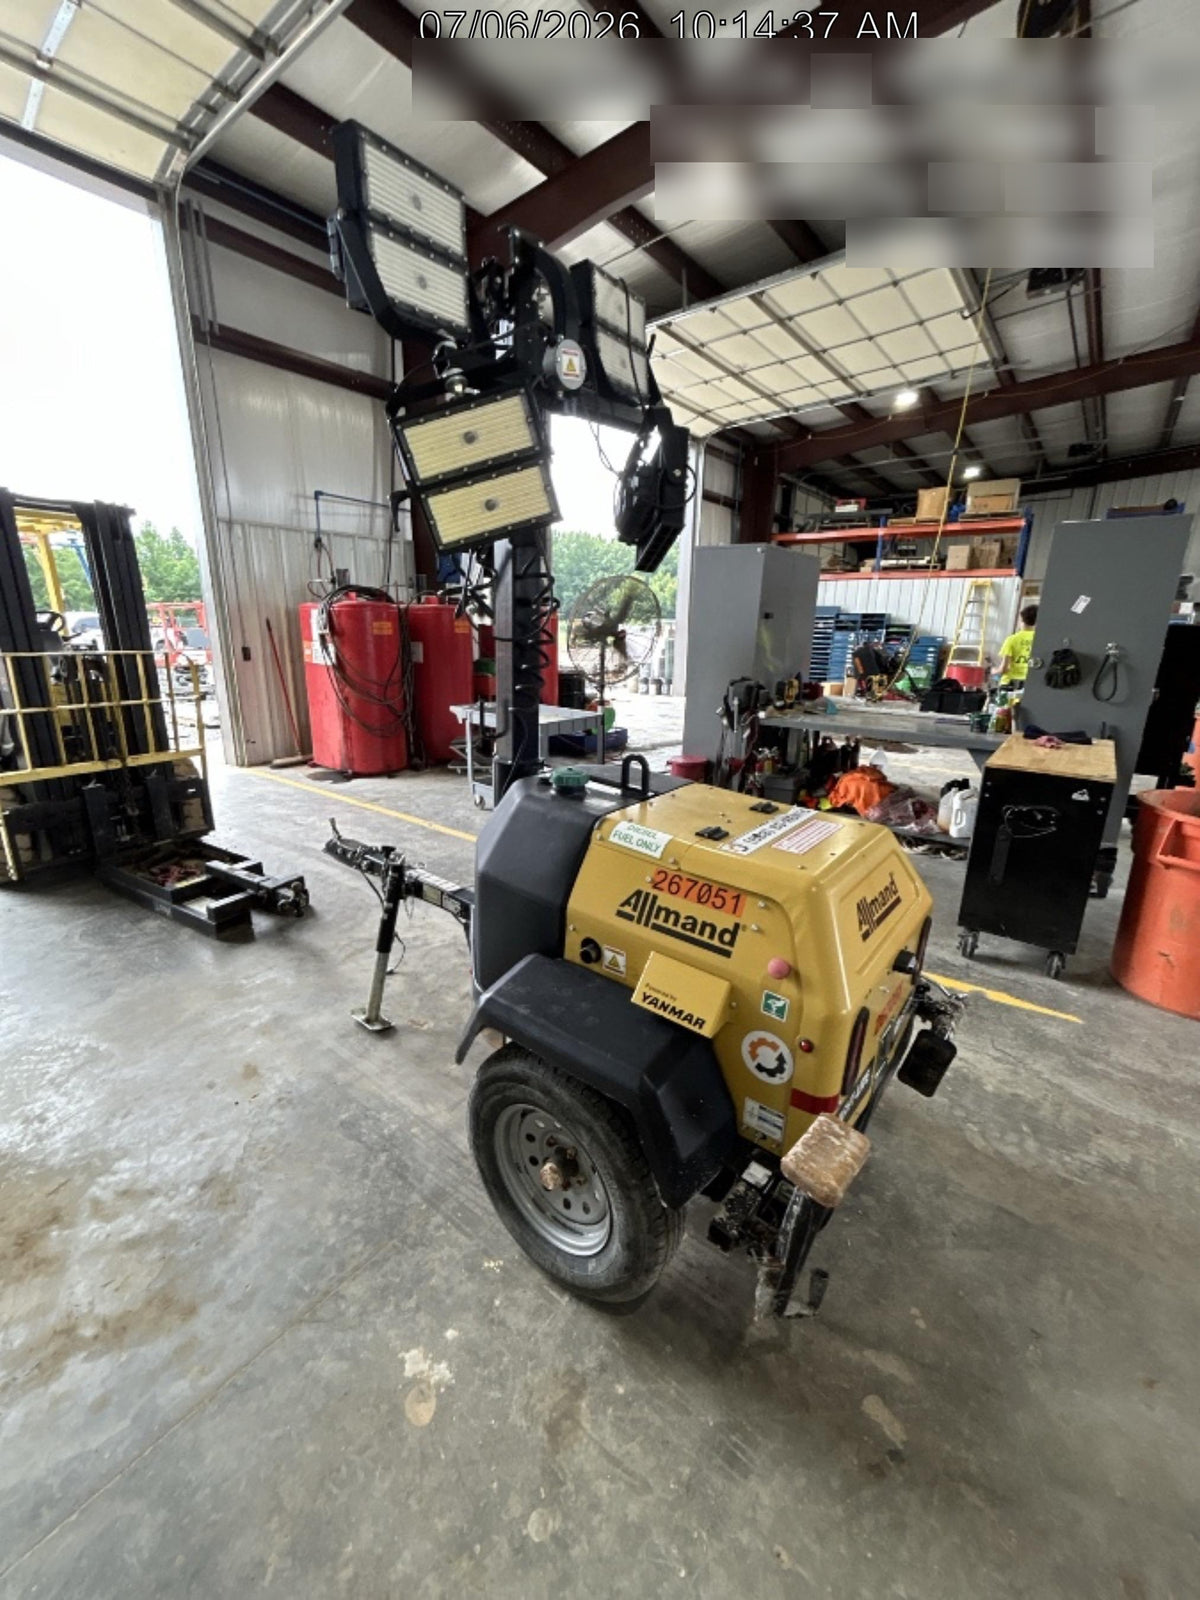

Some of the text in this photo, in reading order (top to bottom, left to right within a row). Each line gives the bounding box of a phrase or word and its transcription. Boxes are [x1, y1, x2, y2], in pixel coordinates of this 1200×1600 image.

[613, 830, 661, 852] FUEL ONLY
[651, 870, 742, 915] 267051
[617, 888, 740, 950] Allmand
[641, 991, 706, 1030] YANMAR
